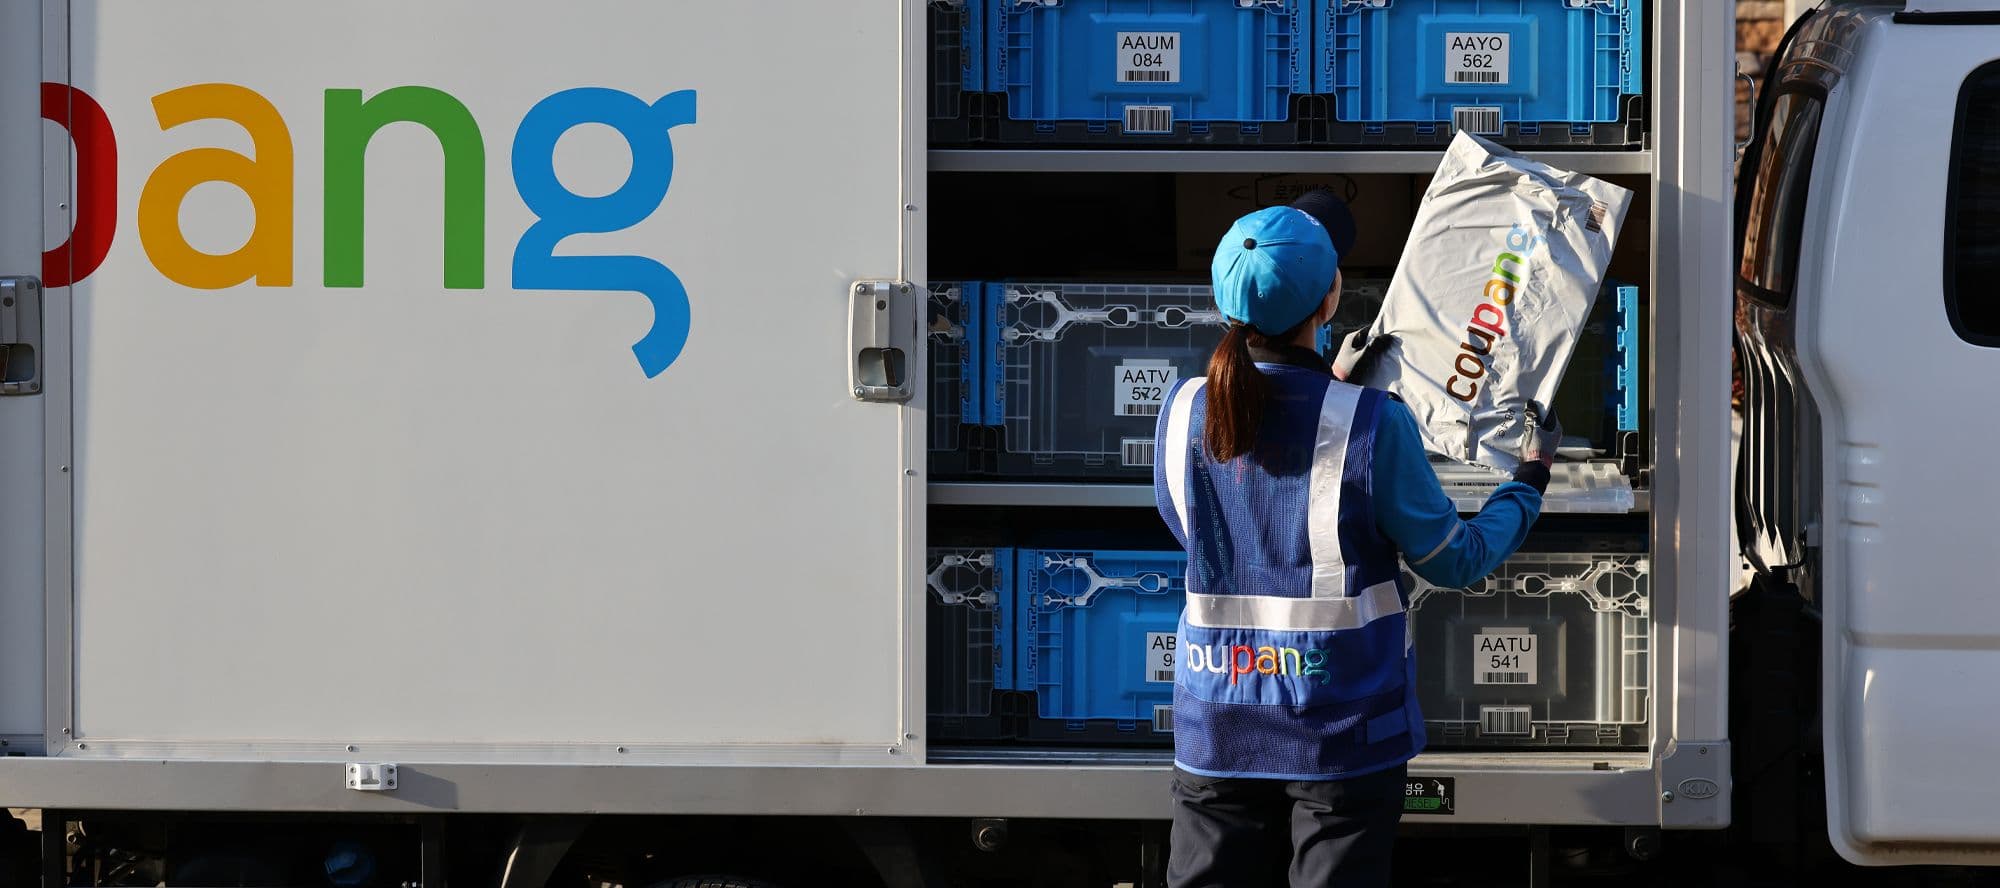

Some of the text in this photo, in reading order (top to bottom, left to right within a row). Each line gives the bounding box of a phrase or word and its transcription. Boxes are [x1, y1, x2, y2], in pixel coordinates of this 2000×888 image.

[1121, 35, 1174, 50] AAUM
[1451, 36, 1503, 51] AAYO
[1132, 53, 1163, 68] 084
[1462, 54, 1493, 69] 562
[1446, 222, 1546, 402] coupang
[1122, 369, 1170, 384] AATV
[1131, 386, 1162, 401] 572
[1479, 635, 1532, 652] AATU
[1163, 652, 1175, 668] 9
[1186, 640, 1331, 686] oupang
[1490, 654, 1519, 669] 541
[1685, 783, 1713, 795] KIA
